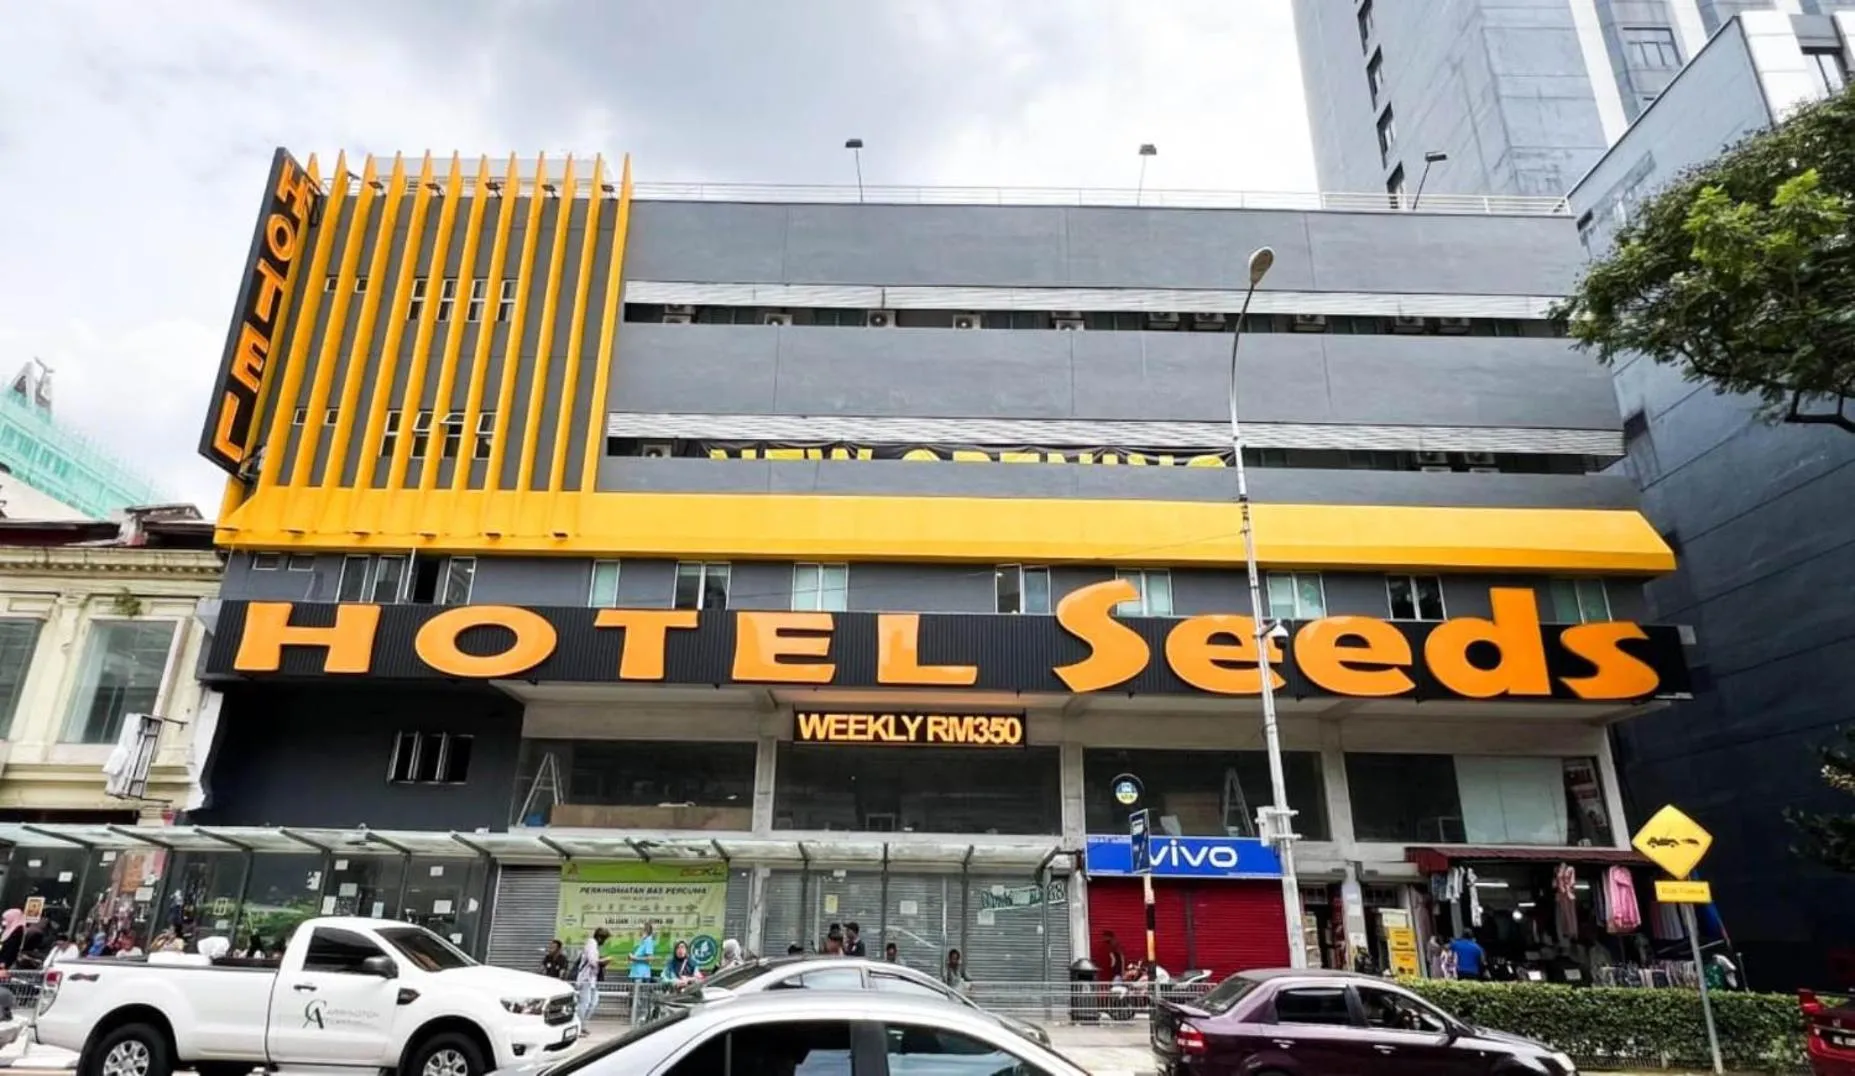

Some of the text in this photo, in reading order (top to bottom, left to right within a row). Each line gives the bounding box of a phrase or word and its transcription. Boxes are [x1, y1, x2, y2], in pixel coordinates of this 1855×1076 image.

[213, 158, 315, 463] HOTEL
[232, 578, 1661, 700] HOTEL Seeds
[798, 713, 1022, 744] WEEKLY RM350
[1149, 840, 1239, 868] vivo
